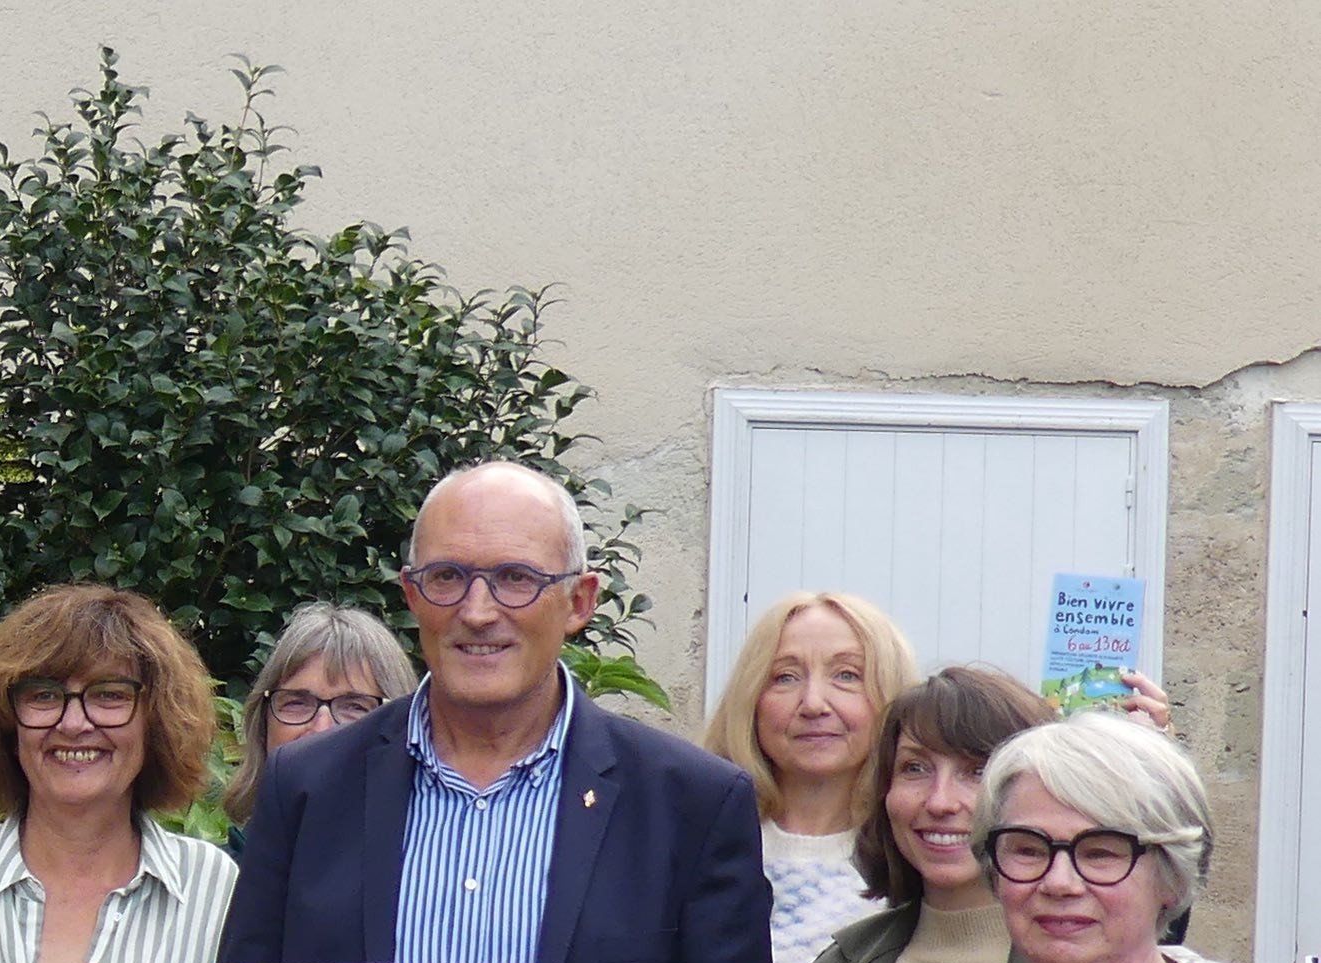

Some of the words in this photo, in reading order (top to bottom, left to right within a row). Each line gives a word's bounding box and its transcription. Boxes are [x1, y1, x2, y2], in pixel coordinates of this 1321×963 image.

[1057, 592, 1087, 608] Bien
[1094, 596, 1135, 612] vivre
[1055, 611, 1135, 627] ensemble
